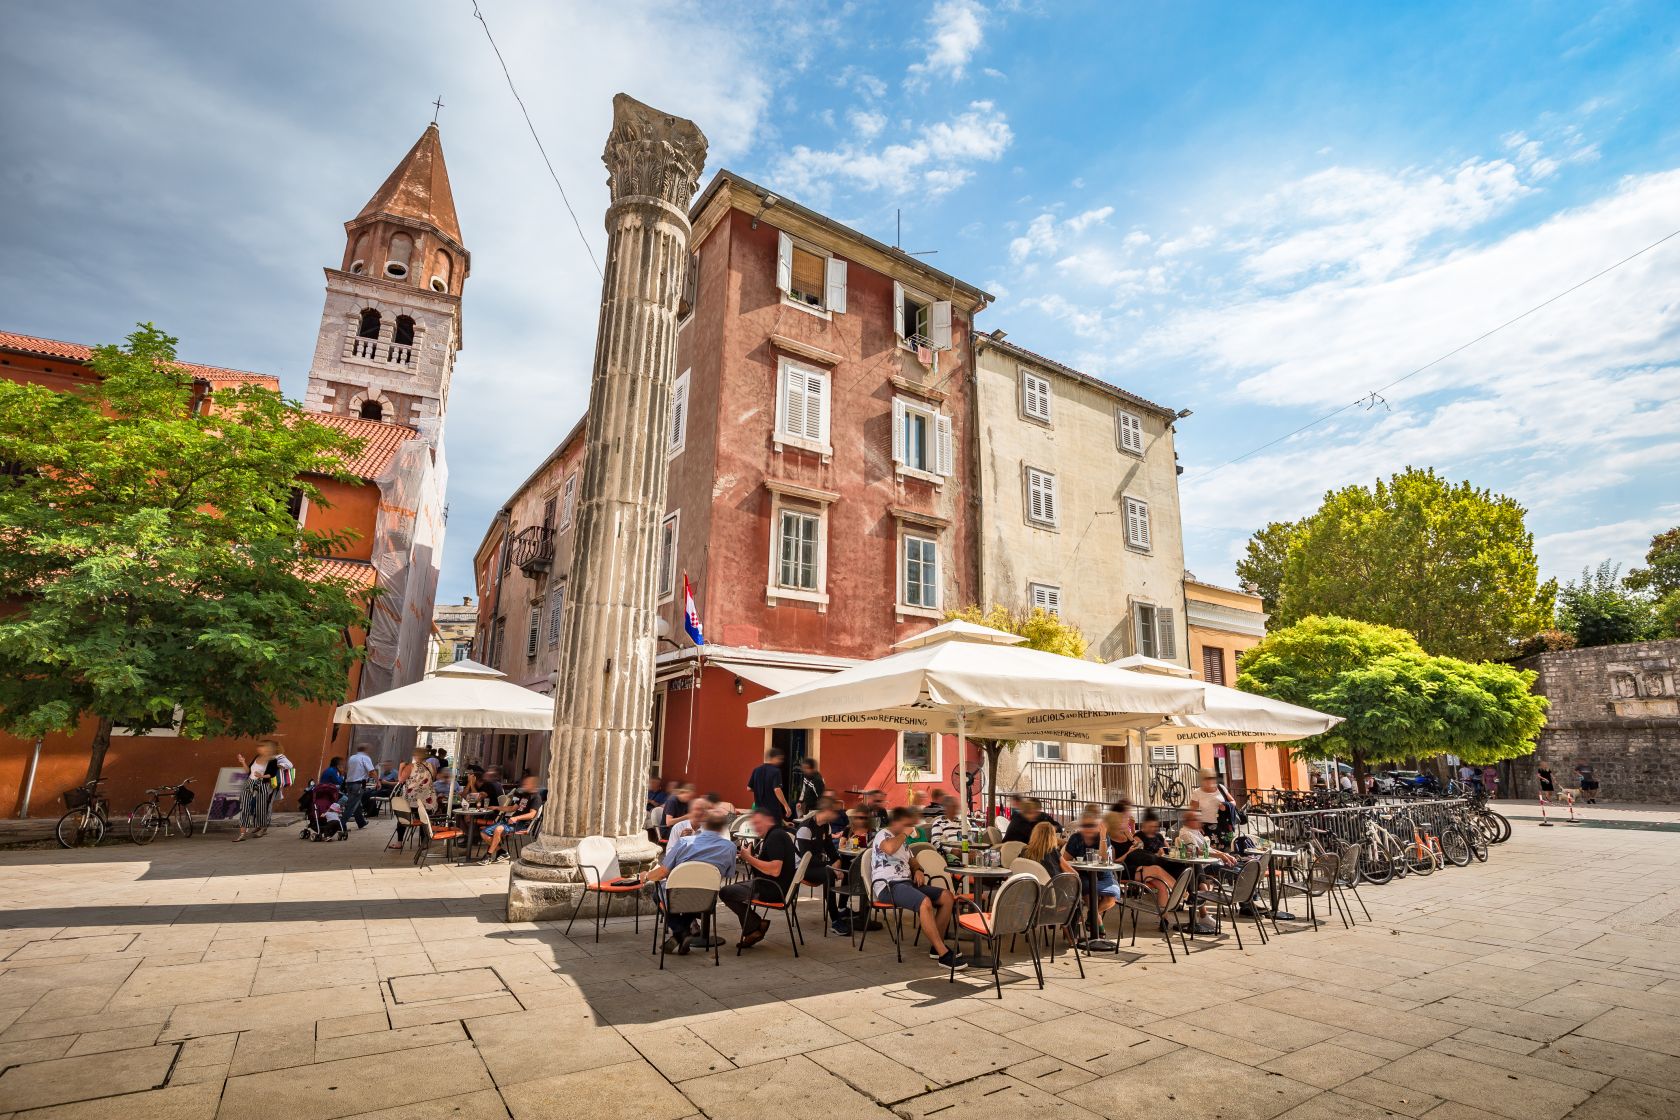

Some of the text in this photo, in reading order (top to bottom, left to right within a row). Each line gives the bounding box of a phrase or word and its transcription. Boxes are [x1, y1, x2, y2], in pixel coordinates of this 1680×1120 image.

[821, 714, 866, 723] DELICIOUS
[878, 714, 928, 726] REFRESHING
[1027, 712, 1066, 724] DELICIOUS
[1053, 730, 1090, 740] REFRESHING
[1176, 730, 1216, 740] DELICIOUS
